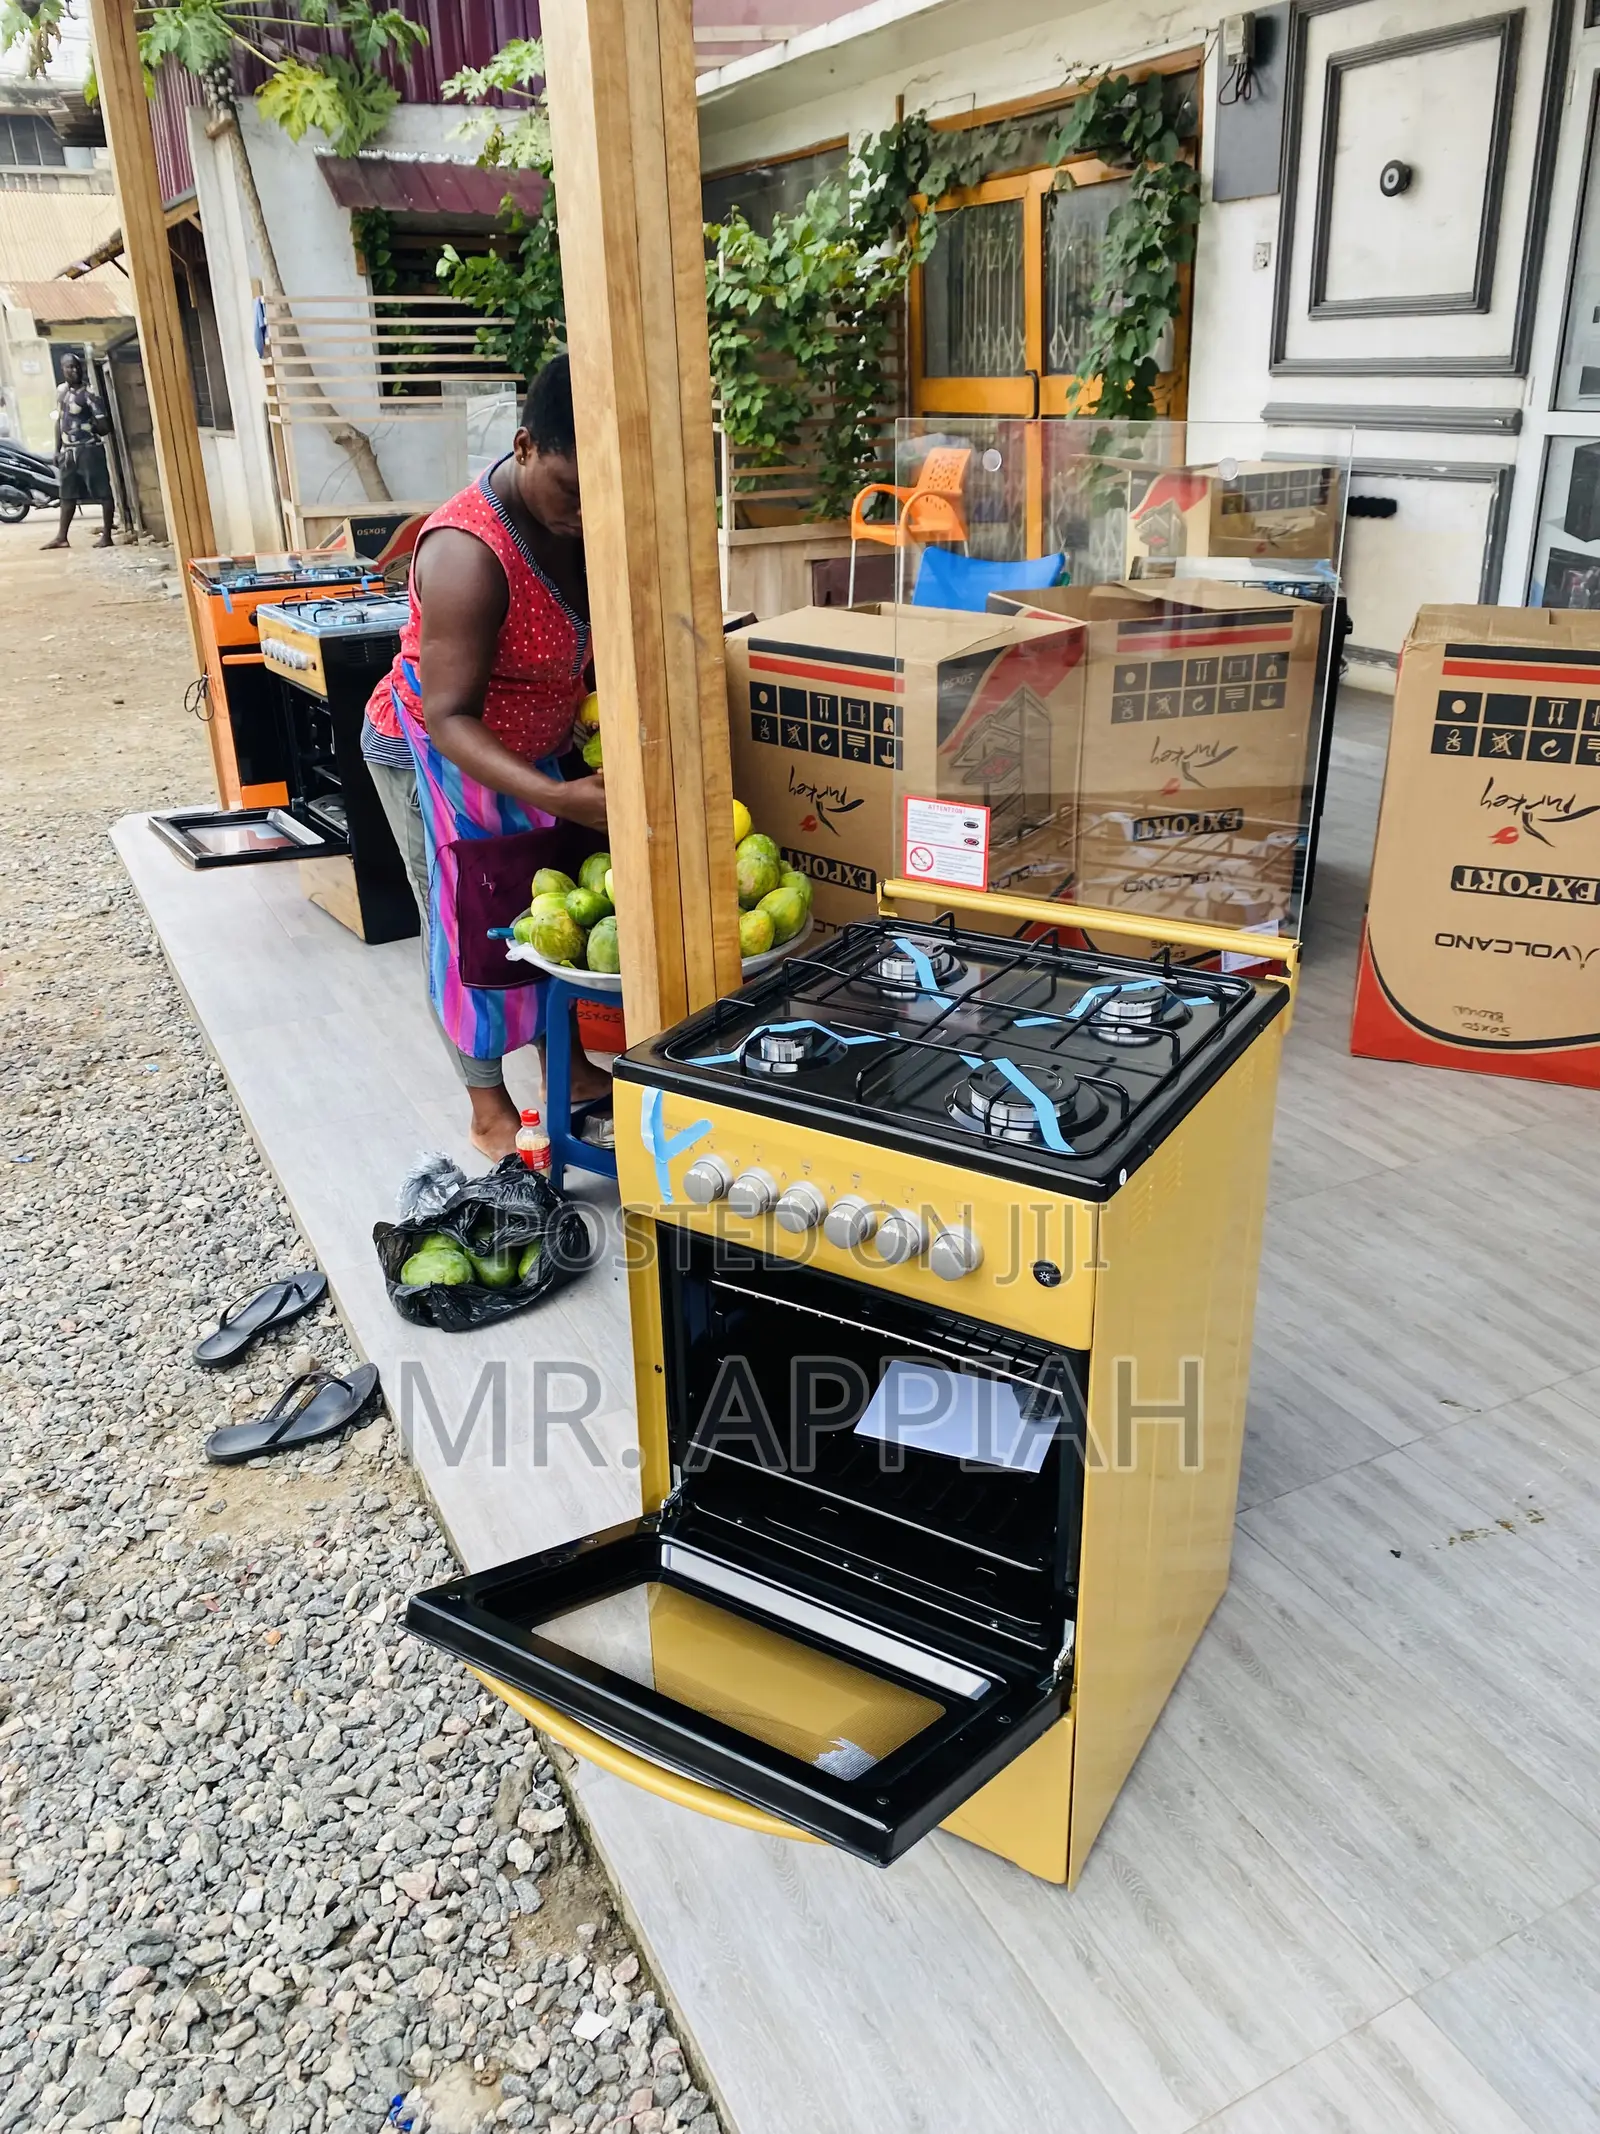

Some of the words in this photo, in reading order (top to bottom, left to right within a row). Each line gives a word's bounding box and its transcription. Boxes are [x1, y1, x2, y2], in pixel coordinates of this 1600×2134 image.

[1150, 736, 1239, 768] Turkey
[788, 765, 865, 813] Turkey
[1480, 776, 1600, 823] Turkey
[1136, 809, 1239, 840] EXPORT
[1122, 870, 1224, 893] VOLCANO
[1455, 867, 1600, 902] EXPORT
[1434, 932, 1572, 961] VOLCANO
